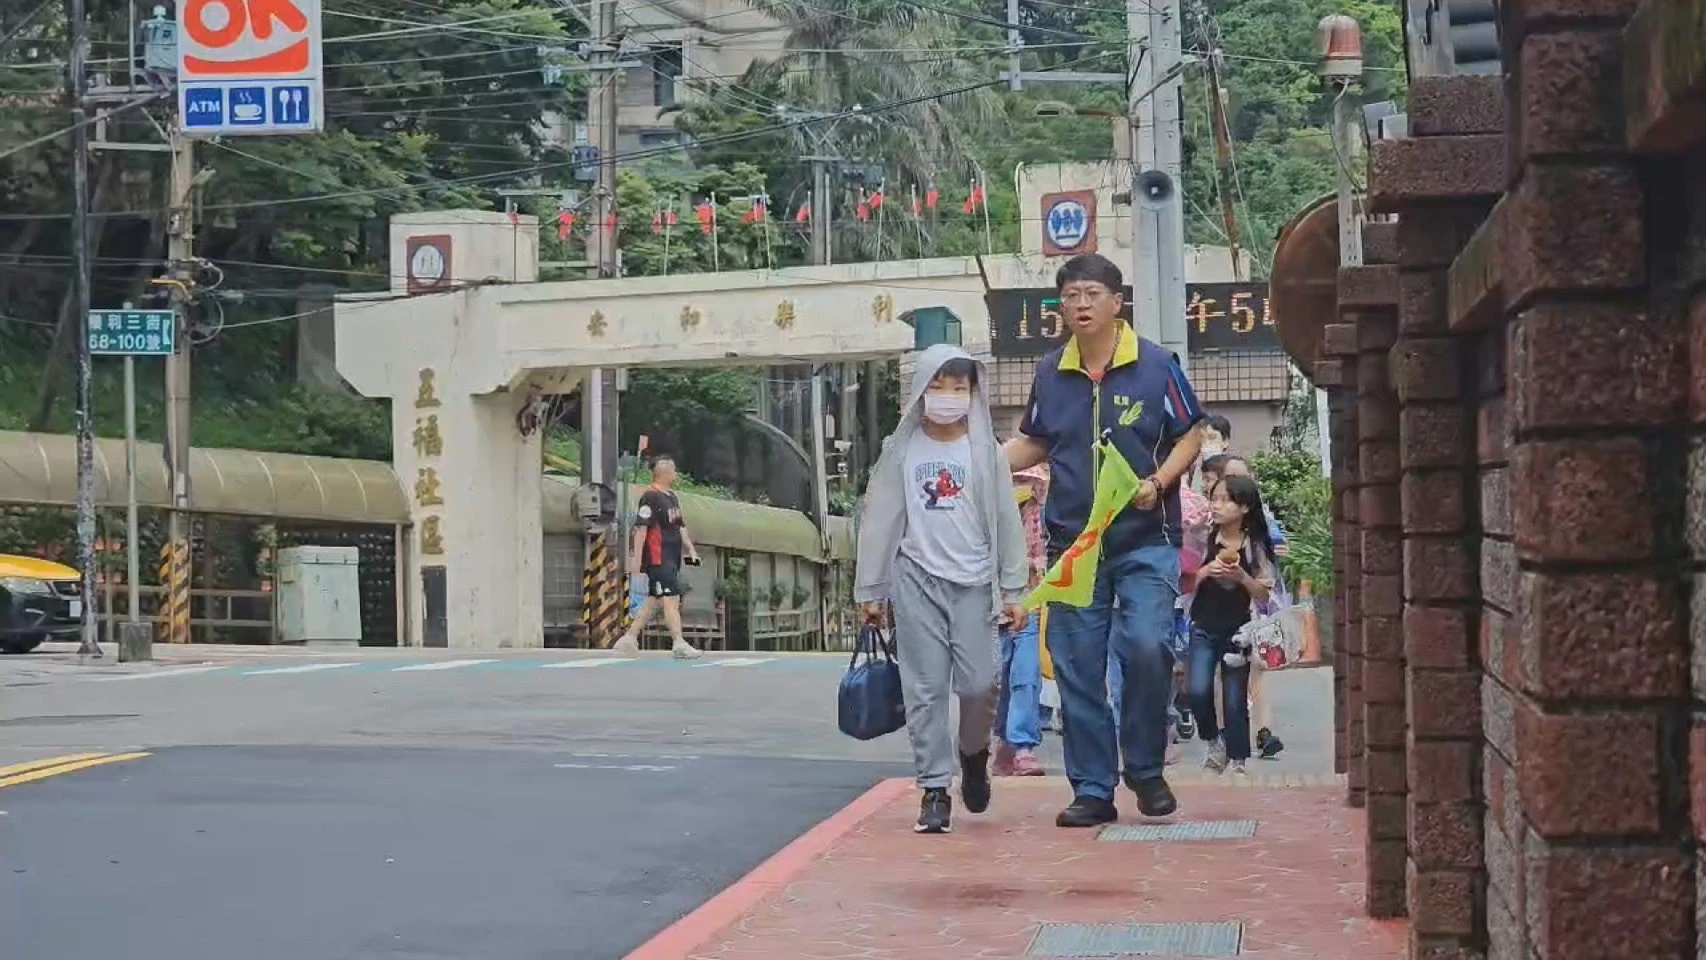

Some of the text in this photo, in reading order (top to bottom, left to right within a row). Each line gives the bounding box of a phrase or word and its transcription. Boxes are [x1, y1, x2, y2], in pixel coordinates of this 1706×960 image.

[183, 0, 308, 48] OK
[188, 100, 220, 113] ATM
[413, 367, 443, 555] 五福社區
